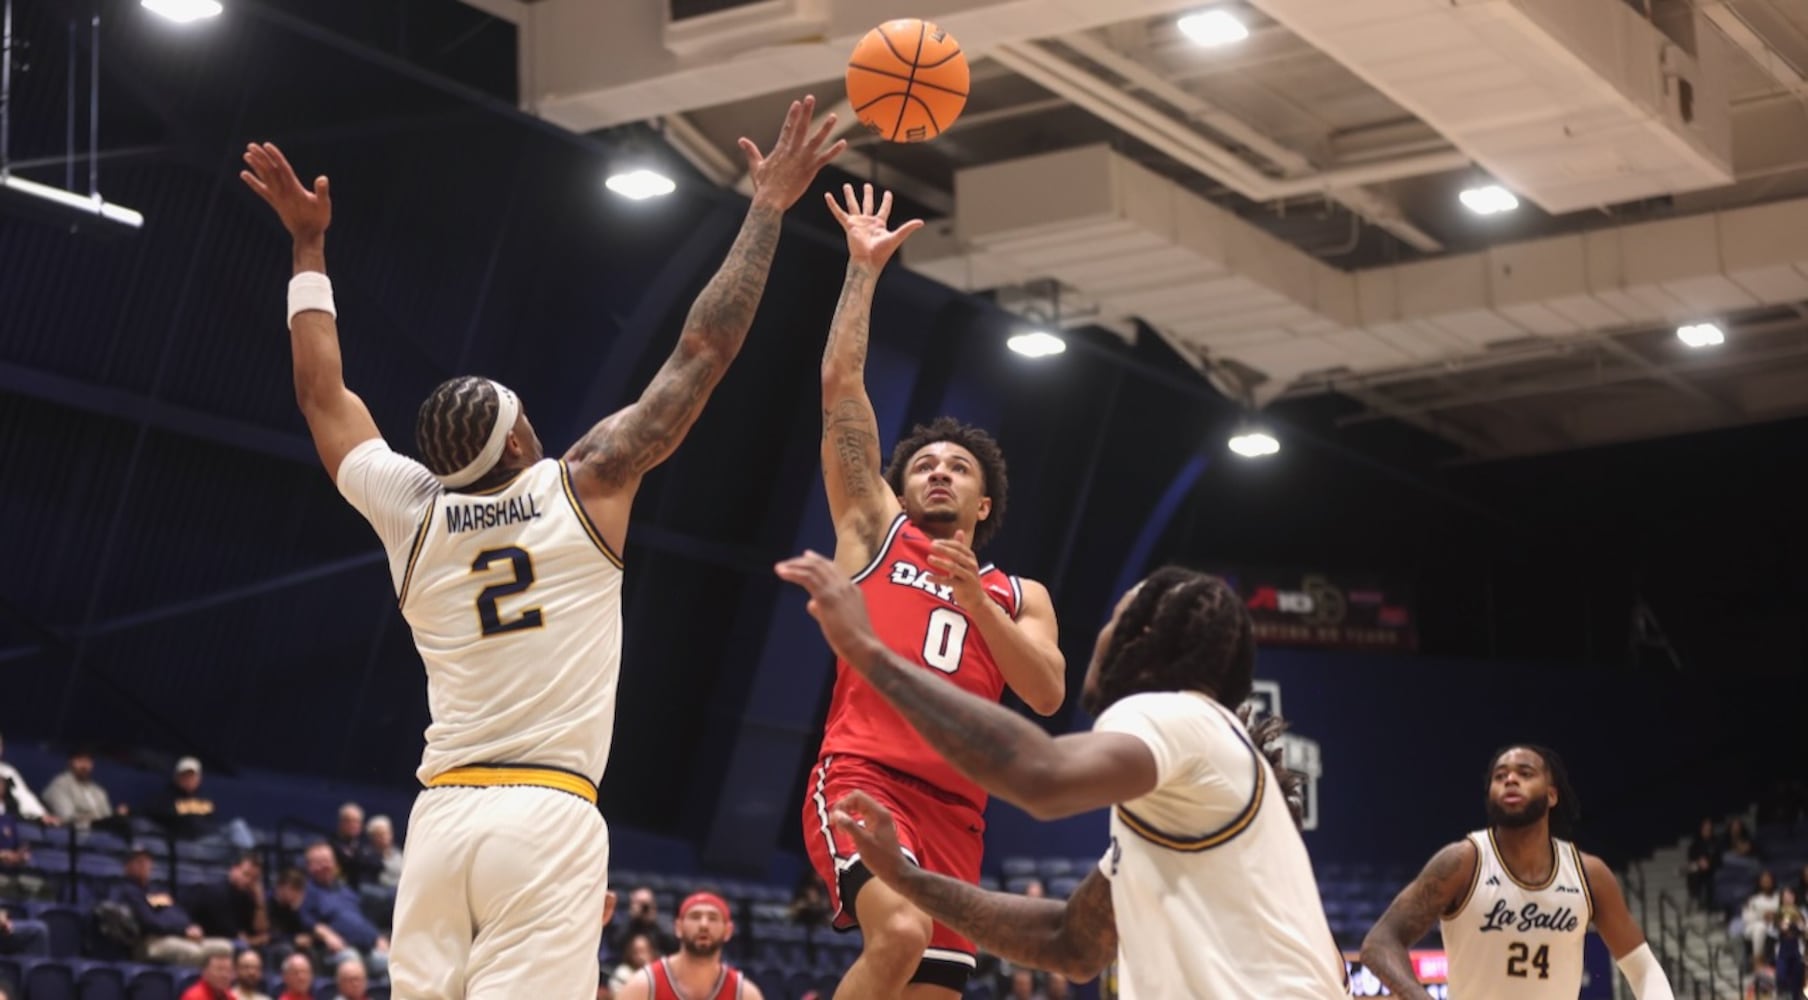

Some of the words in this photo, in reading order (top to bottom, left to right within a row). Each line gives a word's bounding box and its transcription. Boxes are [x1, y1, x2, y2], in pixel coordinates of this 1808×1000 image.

[446, 493, 541, 533] MARSHALL
[470, 545, 544, 637] 2
[889, 560, 958, 606] DAY
[922, 606, 969, 675] 0
[1480, 899, 1517, 932] La
[1517, 903, 1578, 932] Salle
[1507, 942, 1549, 979] 24
